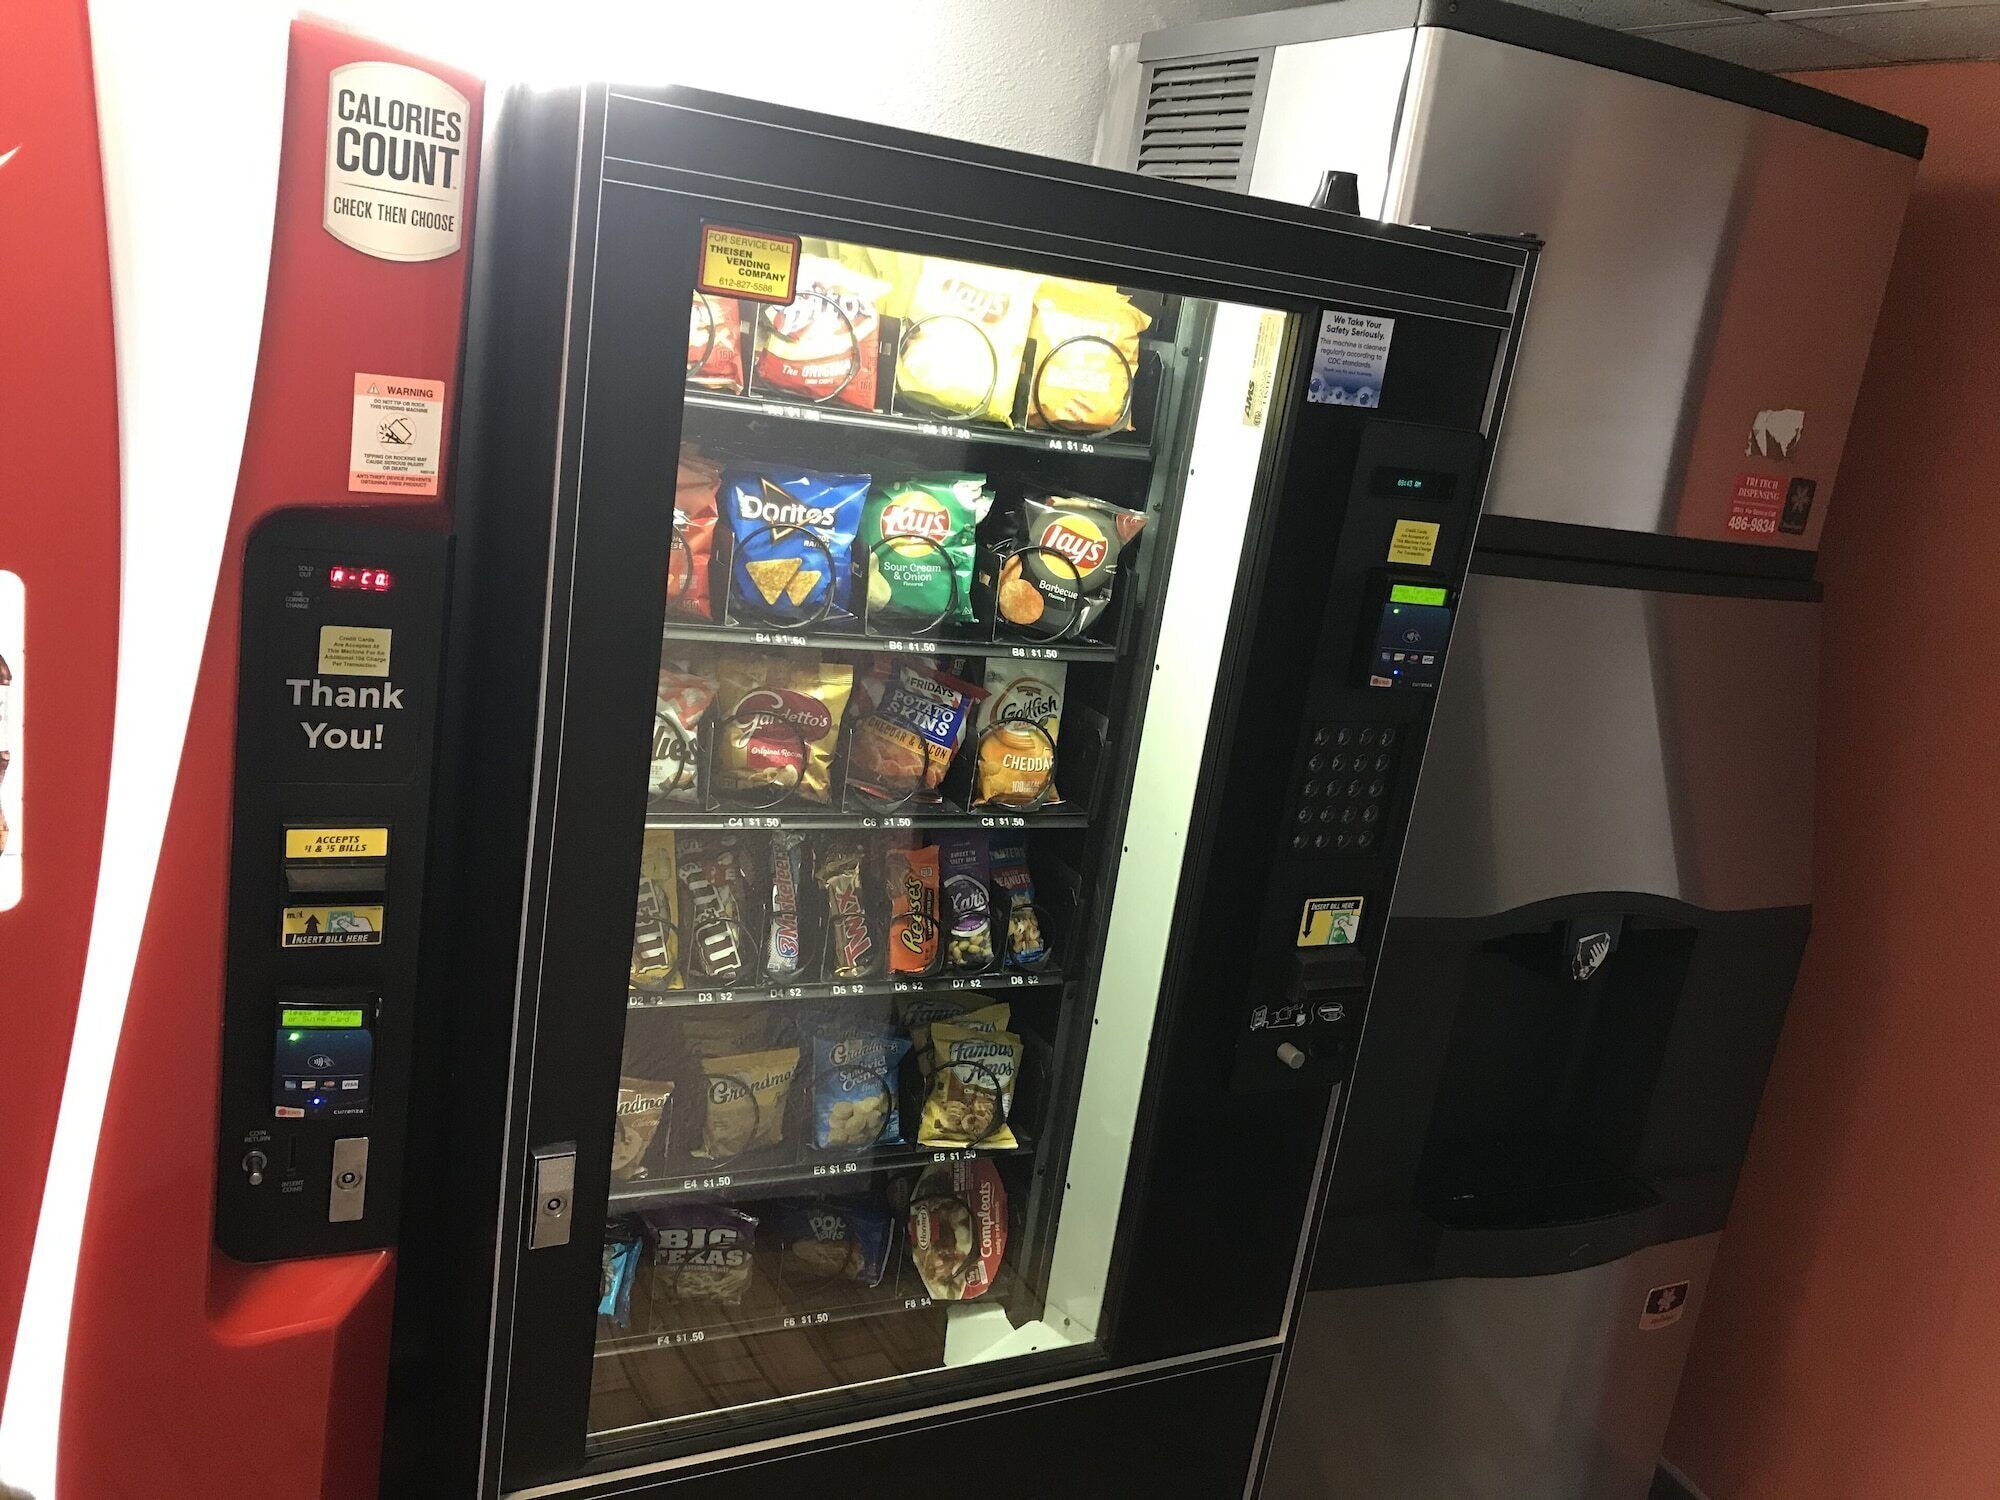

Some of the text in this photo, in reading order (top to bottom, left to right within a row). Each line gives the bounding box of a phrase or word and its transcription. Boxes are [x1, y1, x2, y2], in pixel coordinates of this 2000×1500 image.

[338, 88, 462, 143] CALORIES
[336, 126, 460, 189] COUNT
[333, 196, 455, 232] CHECK THEN CHOOSE
[708, 232, 791, 254] FOR SERVICE CALL
[709, 244, 753, 259] THEISEN
[726, 256, 771, 271] VENDING
[738, 268, 786, 282] COMPANY
[718, 276, 773, 293] 612-827-5588
[1333, 315, 1382, 329] We Take Your
[1326, 324, 1386, 341] Safety Seriously.
[1320, 337, 1332, 345] This
[1332, 339, 1357, 349] machine
[1363, 342, 1387, 352] cleaned
[1320, 347, 1383, 361] regularly according to
[1327, 357, 1342, 365] CDC
[387, 385, 434, 398] WARNING
[1737, 487, 1781, 501] DISPENSING
[740, 494, 836, 526] Doritos
[883, 504, 950, 536] Lay's
[1728, 515, 1776, 534] 486-9834
[1042, 525, 1107, 566] Lay's
[883, 561, 942, 574] Sour Cream
[893, 571, 932, 582] & Onion
[1039, 579, 1079, 600] Barbecue
[889, 641, 902, 651] B6
[1012, 648, 1025, 657] B8
[285, 678, 405, 710] Thank
[910, 677, 954, 698] FRIDAYS
[892, 688, 955, 723] POTATO
[1000, 695, 1058, 721] Goldfish
[888, 700, 950, 737] SKINS
[300, 721, 385, 751] You!
[868, 716, 907, 743] CHEDDAR
[908, 735, 915, 747] &
[751, 745, 780, 757] Original
[1011, 780, 1023, 793] 100
[728, 817, 743, 827] C4
[863, 817, 877, 827] C6
[981, 817, 995, 827] C8
[316, 835, 360, 844] ACCEPTS
[314, 845, 322, 853] &
[338, 844, 367, 852] BILLS
[950, 888, 986, 914] Kar's
[324, 935, 344, 943] BILL
[346, 934, 369, 943] HERE
[894, 982, 923, 992] D6 $2
[952, 979, 982, 988] D7 $2
[1010, 976, 1039, 985] D8 $2
[698, 992, 733, 1002] D3 $2
[770, 988, 802, 999] D4 $2
[832, 985, 864, 995] D5 $2
[949, 1040, 1015, 1062] Famous
[933, 1153, 946, 1162] E8
[813, 1166, 826, 1175] E6
[684, 1179, 697, 1189] E4
[977, 1181, 996, 1258] Compleats
[657, 1228, 738, 1249] BIG
[905, 1298, 932, 1309] F8 $4
[783, 1318, 796, 1327] F6
[657, 1336, 670, 1346] F4
